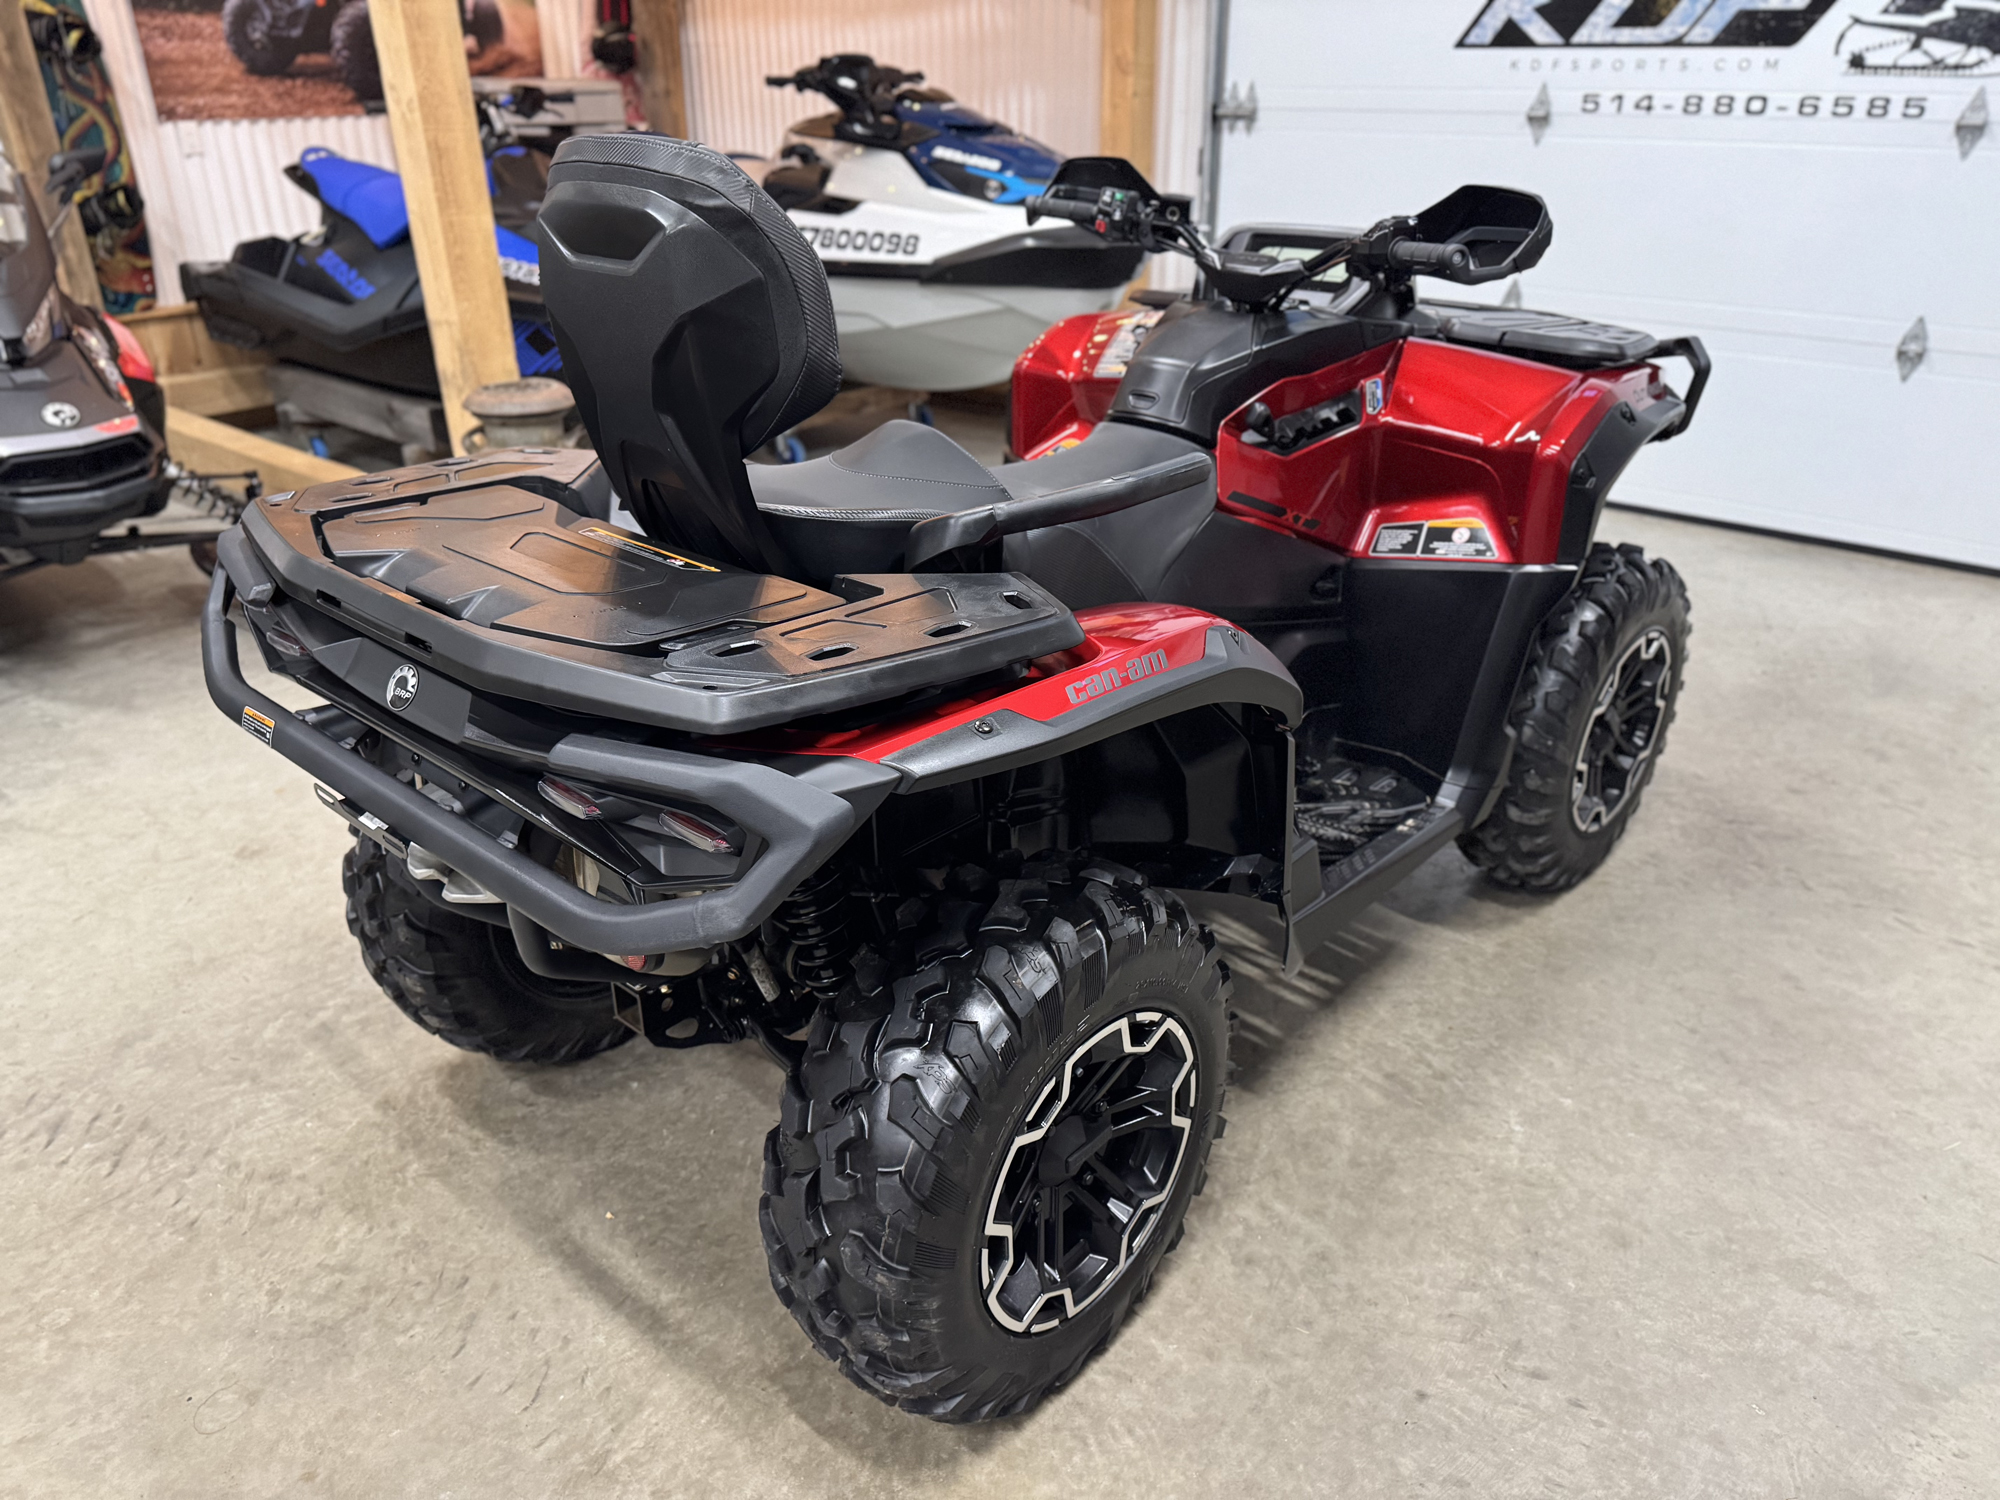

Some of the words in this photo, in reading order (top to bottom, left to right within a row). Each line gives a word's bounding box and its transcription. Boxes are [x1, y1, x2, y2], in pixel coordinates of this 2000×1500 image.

[1508, 58, 1781, 72] KDFSPORTS.COM
[1581, 93, 1928, 118] 514-880-6585
[798, 226, 919, 255] 7800098
[1065, 648, 1169, 704] can-am
[394, 687, 412, 699] BRP
